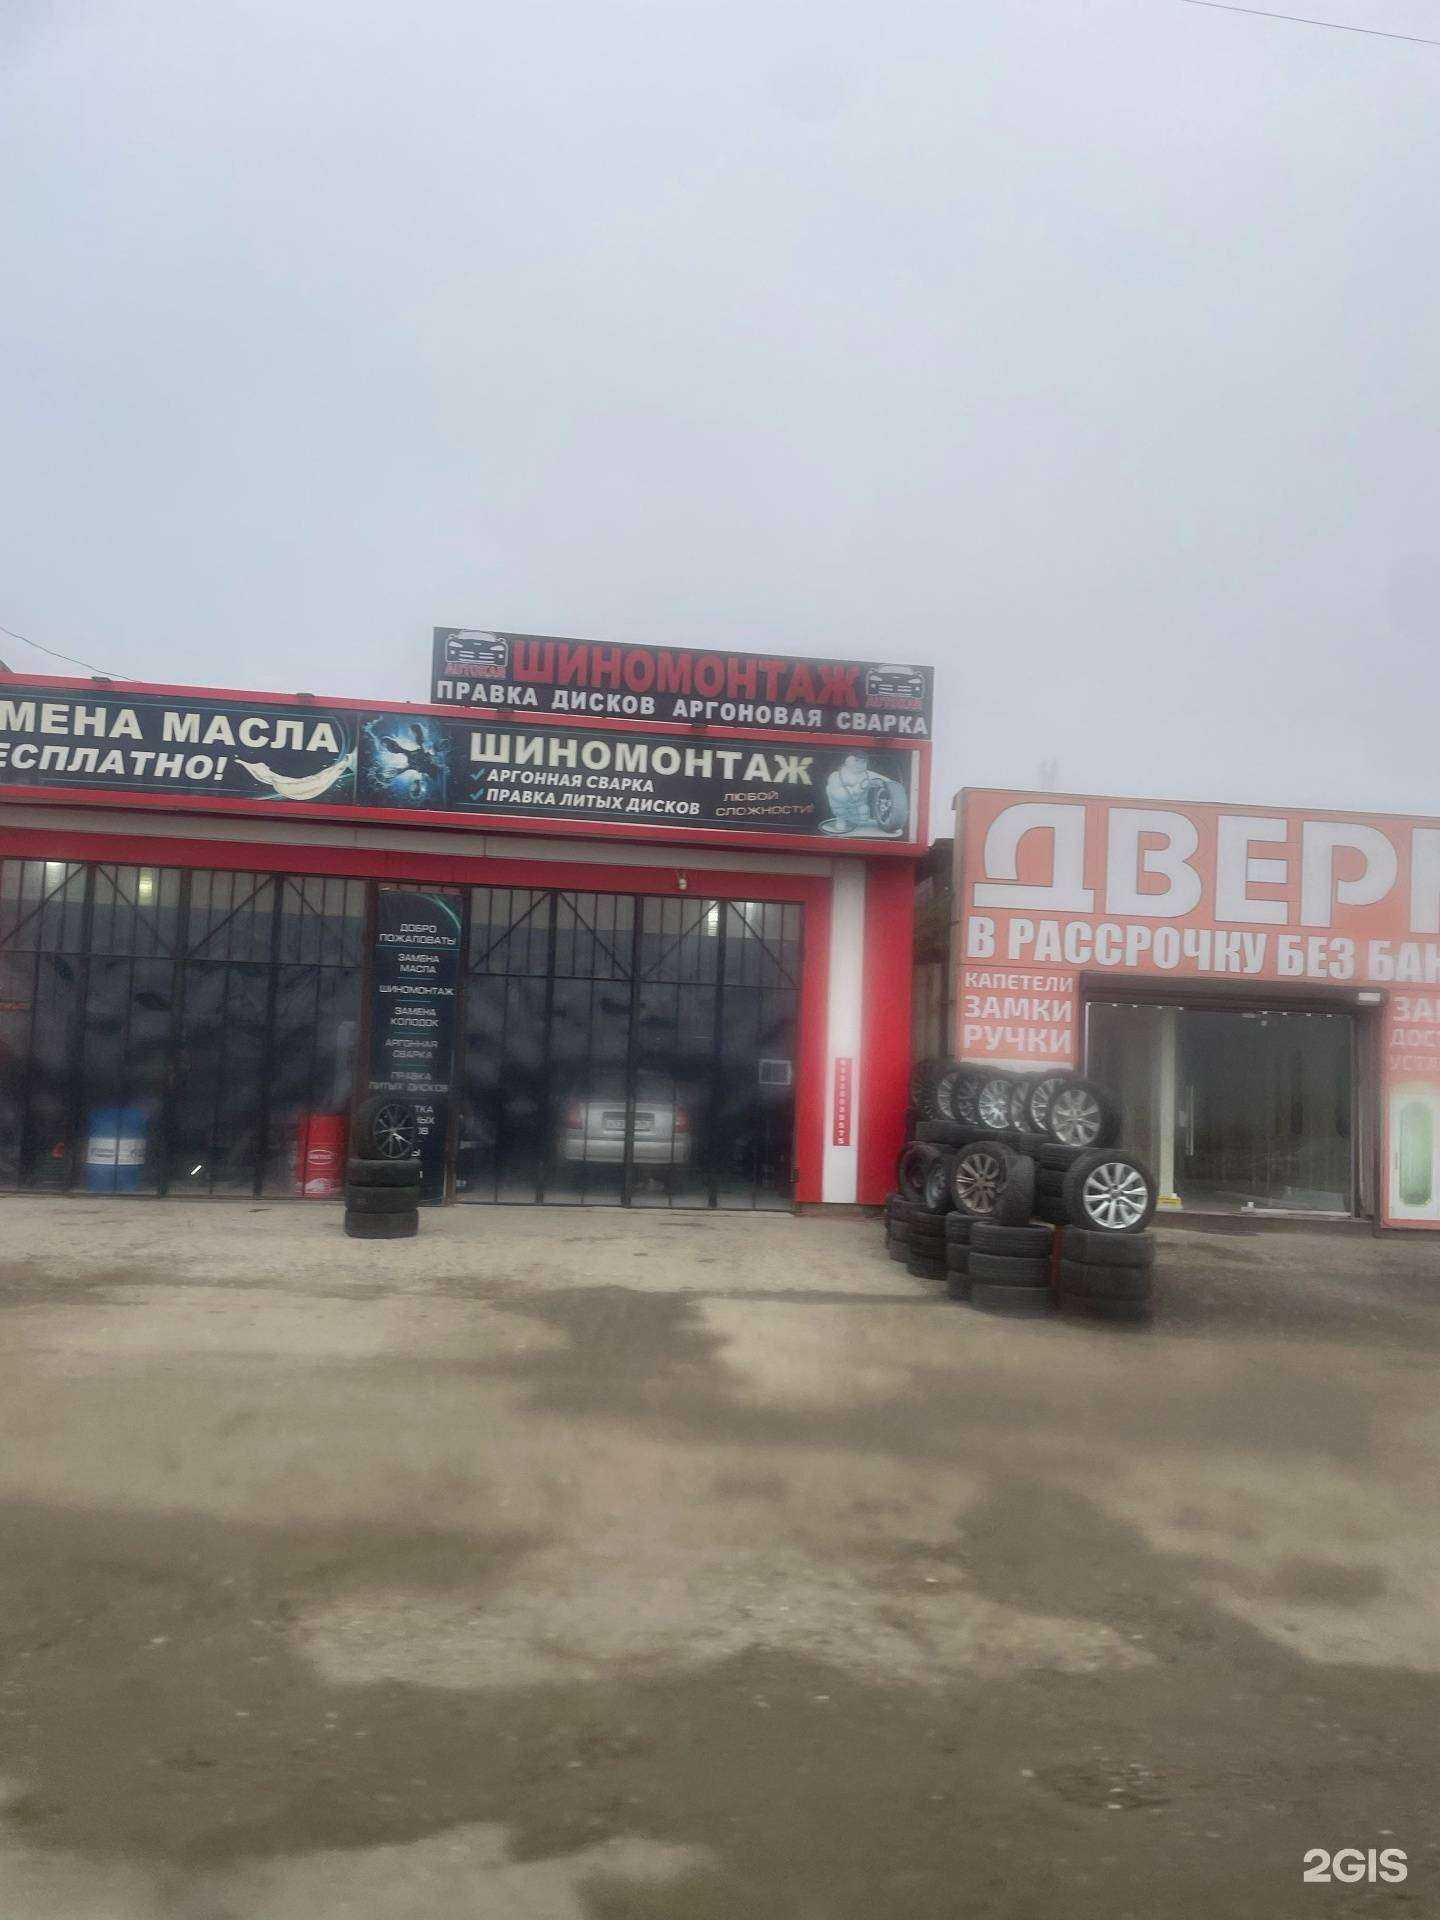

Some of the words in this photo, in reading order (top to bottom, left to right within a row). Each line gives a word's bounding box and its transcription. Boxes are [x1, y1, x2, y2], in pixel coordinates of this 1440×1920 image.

[513, 640, 859, 708] ШИНОМОНТАЖ
[437, 680, 538, 706] ПРАВКА
[551, 689, 656, 715] ДИСКОВ
[672, 699, 822, 727] АРГОНОВАЯ
[836, 711, 928, 735] СВАРКА
[163, 711, 339, 753] МАСЛА
[470, 732, 813, 786] ШИНОМОНТАЖ
[487, 769, 581, 788] АРГОННАЯ
[586, 775, 655, 792] СВАРКА
[487, 788, 558, 806] ПРАВКА
[560, 793, 623, 810] ЛИТЫХ
[625, 797, 700, 815] ДИСКОВ
[723, 790, 779, 802] ЛЮБОЙ
[400, 923, 437, 934] ДОБРО
[398, 953, 440, 963] ЗАМЕНА
[967, 916, 995, 959] В
[1008, 918, 1267, 974] РАССРОЧКУ
[1276, 934, 1355, 980] БЕЗ
[400, 964, 437, 974] МАСЛА
[379, 985, 456, 996] ШИНОМОНТАЖ
[965, 972, 1073, 992] КАПЕТЕЛИ
[394, 1006, 437, 1017] ЗАМЕНА
[964, 995, 1072, 1022] ЗАМКИ
[963, 1024, 1072, 1054] РУЧКИ
